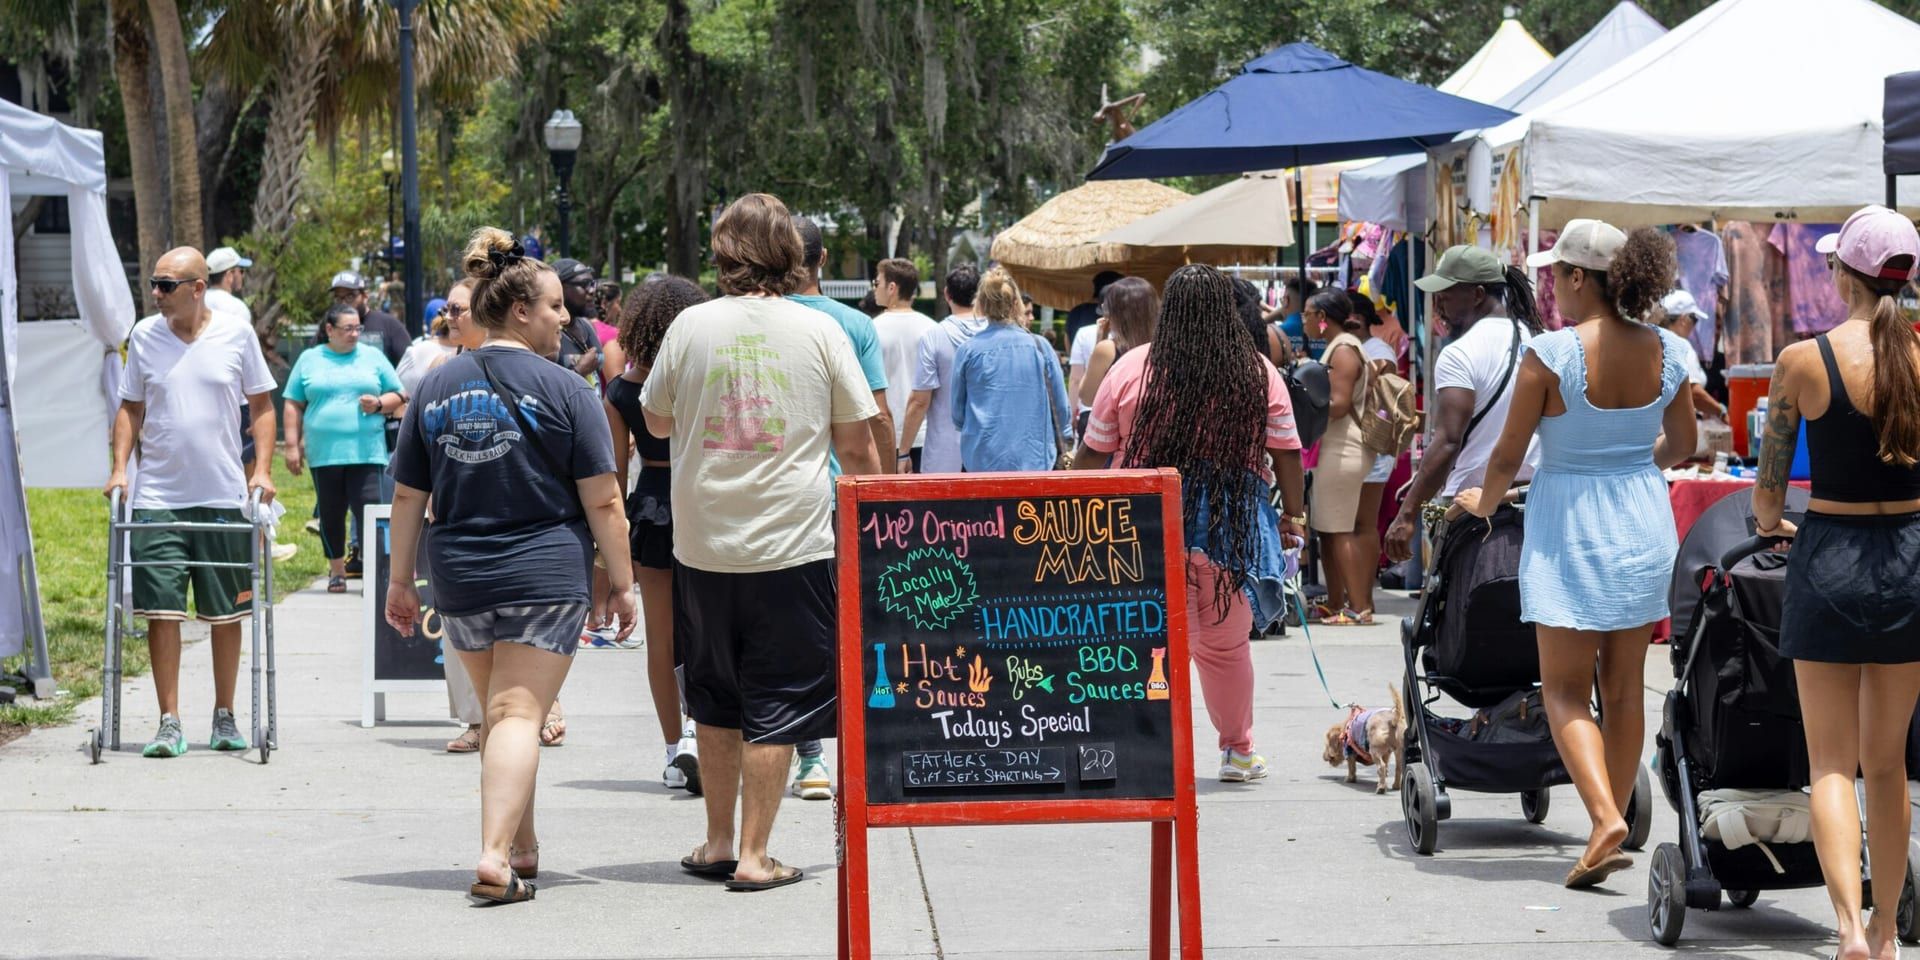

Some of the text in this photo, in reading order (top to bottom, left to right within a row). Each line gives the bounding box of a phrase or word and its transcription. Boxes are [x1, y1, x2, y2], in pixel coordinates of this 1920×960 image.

[862, 505, 1005, 558] The Original
[1013, 498, 1137, 545] SAUCE
[1035, 541, 1144, 585] MAN
[889, 566, 957, 599] Locally
[915, 588, 962, 620] Made
[982, 600, 1163, 640] HANDCRAFTED
[902, 643, 962, 681] Hot
[1078, 645, 1139, 673] BBQ
[915, 680, 986, 708] Sauces
[1006, 655, 1044, 700] Rubs
[1067, 671, 1145, 704] Sauces
[931, 704, 1090, 748] Today's Special
[909, 749, 1041, 769] FATHER'S DAY
[984, 768, 1043, 783] STARTING
